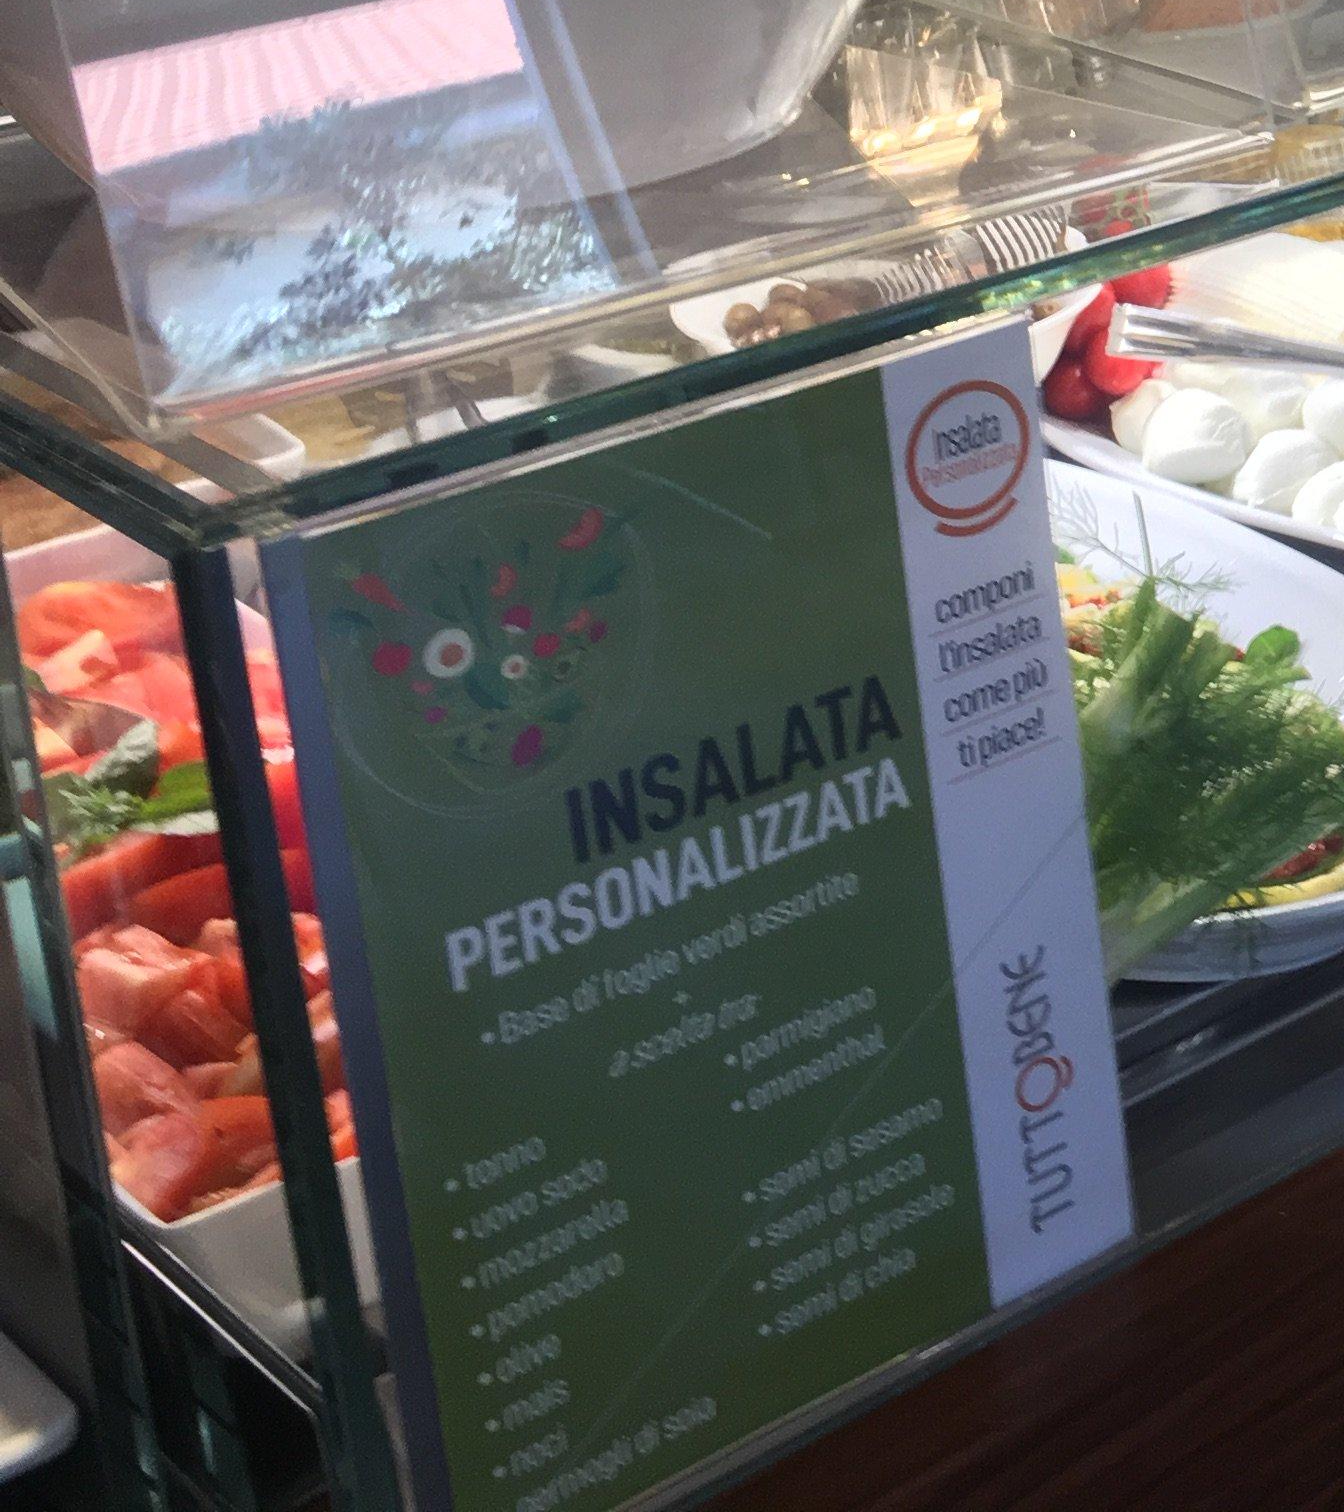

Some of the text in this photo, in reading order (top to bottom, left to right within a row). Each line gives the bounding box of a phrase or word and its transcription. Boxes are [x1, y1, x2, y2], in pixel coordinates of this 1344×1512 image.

[935, 560, 1035, 623] componi
[943, 658, 1049, 722] come più
[956, 706, 1048, 768] ti piace!
[564, 674, 902, 864] INSALATA
[445, 757, 911, 992] PERSONALIZZATA
[999, 944, 1076, 1234] TUTTOBENE
